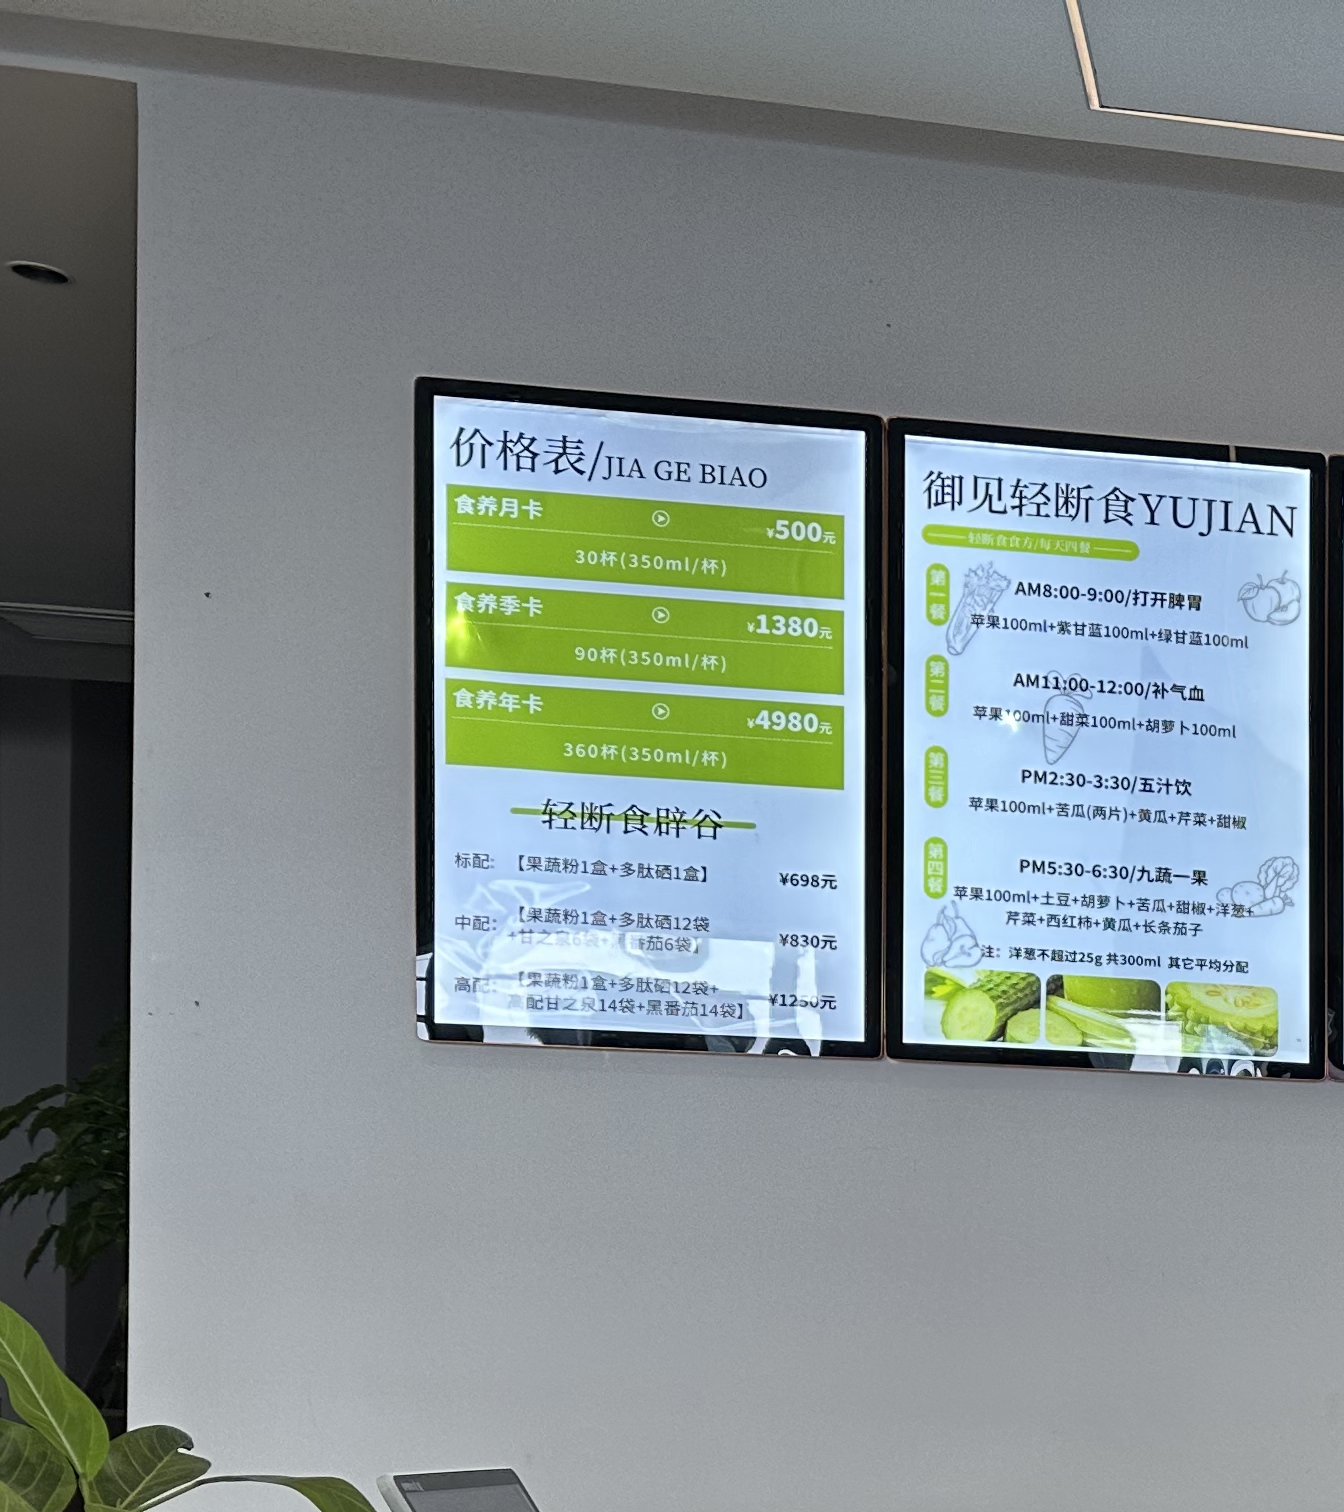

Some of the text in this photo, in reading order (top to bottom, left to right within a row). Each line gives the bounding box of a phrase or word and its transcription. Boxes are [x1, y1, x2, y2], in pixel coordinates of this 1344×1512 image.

[654, 460, 691, 482] GE
[700, 464, 768, 488] BIAO
[454, 494, 836, 545] 食养月卡 ¥500元
[922, 470, 1298, 538] 御见轻断食YUJIAN
[575, 549, 727, 577] 30杯(350ml/杯)
[930, 568, 946, 621] 第一餐
[1015, 581, 1202, 612] AM8:00-9:00/打开脾胃
[454, 591, 832, 640] 食养季卡 ¥1380元
[970, 613, 1249, 649] 苹果100ml+紫甘蓝100ml+绿甘蓝100ml
[574, 646, 727, 673] 90杯(350ml/杯)
[929, 660, 946, 712] 第二餐
[1013, 673, 1205, 702] AM11:00-12:00/补气血
[453, 687, 832, 735] 食养年卡 ¥4980元
[563, 742, 727, 769] 360杯(350ml/杯)
[928, 751, 945, 804] 第三餐
[1021, 768, 1192, 797] PM2:30-3:30/五汁饮
[541, 798, 724, 840] 轻断食辟谷
[968, 796, 1247, 831] 苹果100ml+苦瓜(两片)+黄瓜+芹菜+甜椒
[779, 872, 837, 890] ¥698元
[927, 842, 945, 895] 第四餐
[1019, 859, 1208, 886] PM5:30-6:30/九蔬一果
[1005, 911, 1203, 937] 芹菜+西红柿+黄瓜+长条茄子
[779, 932, 837, 951] ¥830元
